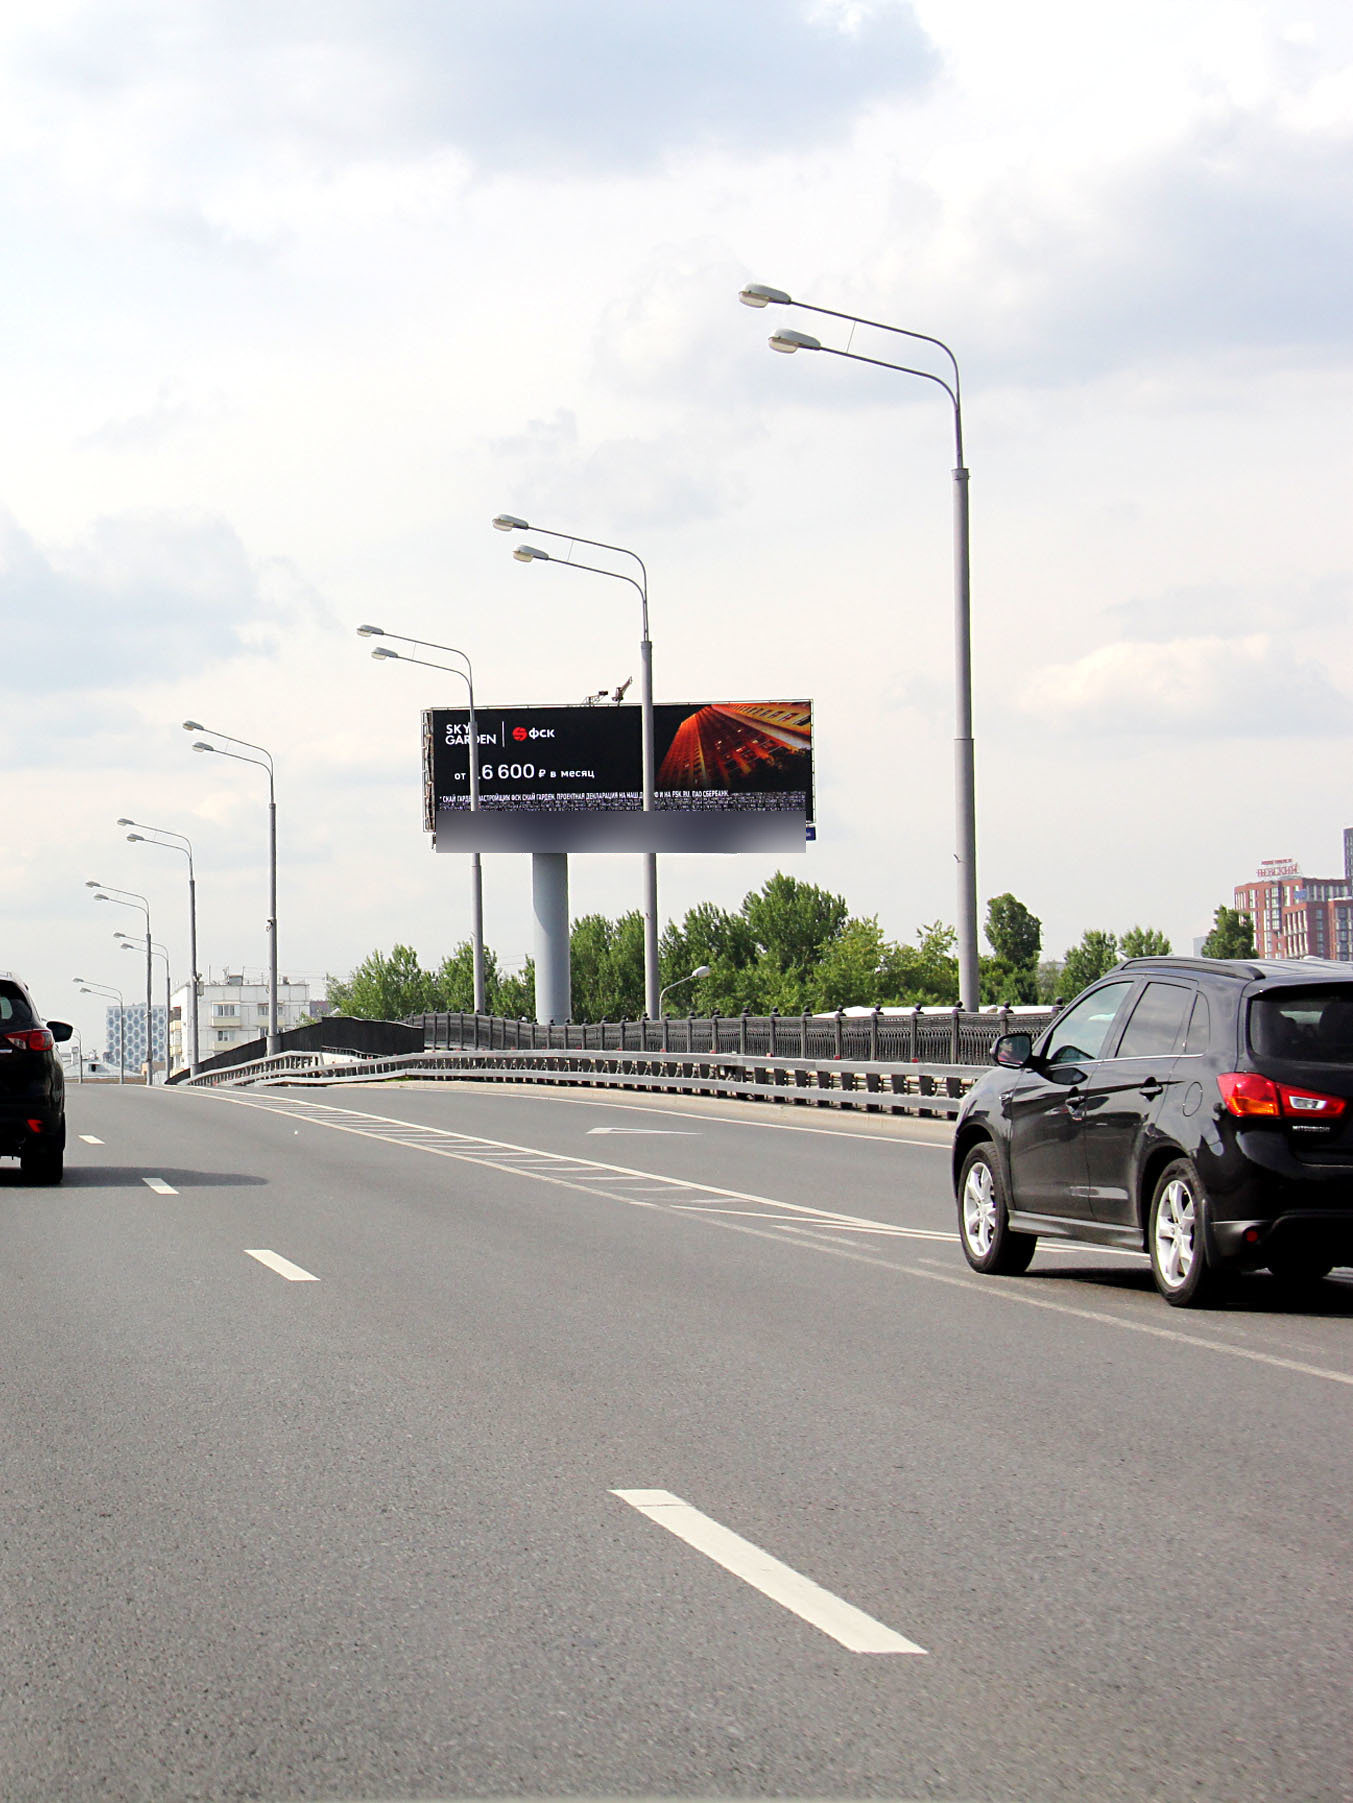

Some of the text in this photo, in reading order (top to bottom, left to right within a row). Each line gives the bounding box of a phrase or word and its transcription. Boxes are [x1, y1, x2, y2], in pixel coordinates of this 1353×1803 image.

[445, 723, 471, 735] SKY
[454, 772, 466, 781] от
[497, 763, 535, 779] 600
[550, 770, 557, 778] в
[560, 769, 596, 779] месяц
[478, 793, 511, 802] АСТРОЙЩИК
